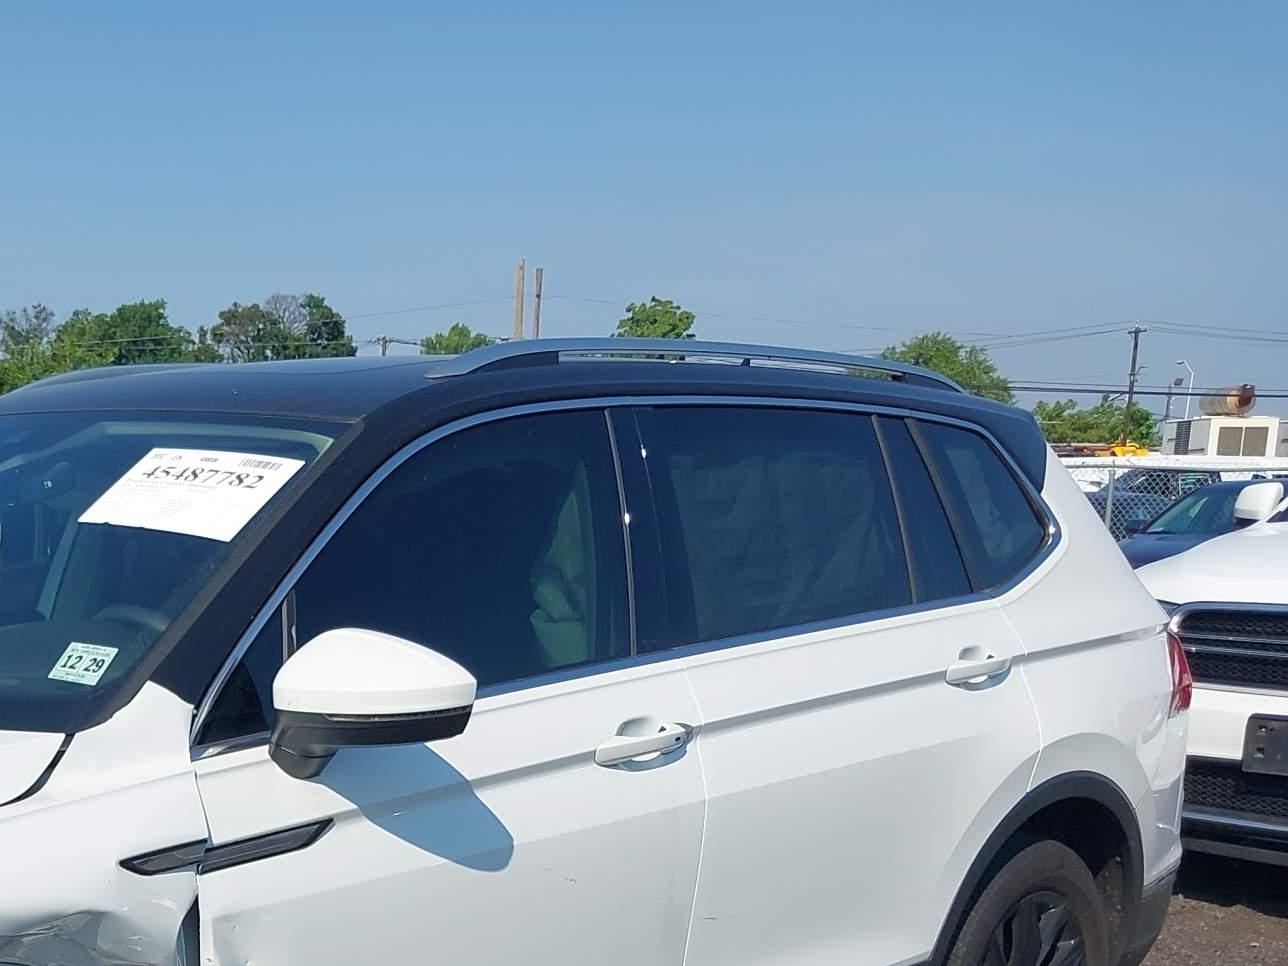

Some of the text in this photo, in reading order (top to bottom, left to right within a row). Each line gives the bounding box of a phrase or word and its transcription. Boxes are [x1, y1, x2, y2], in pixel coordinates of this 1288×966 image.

[142, 465, 265, 489] 45487782
[60, 654, 106, 673] 12 29
